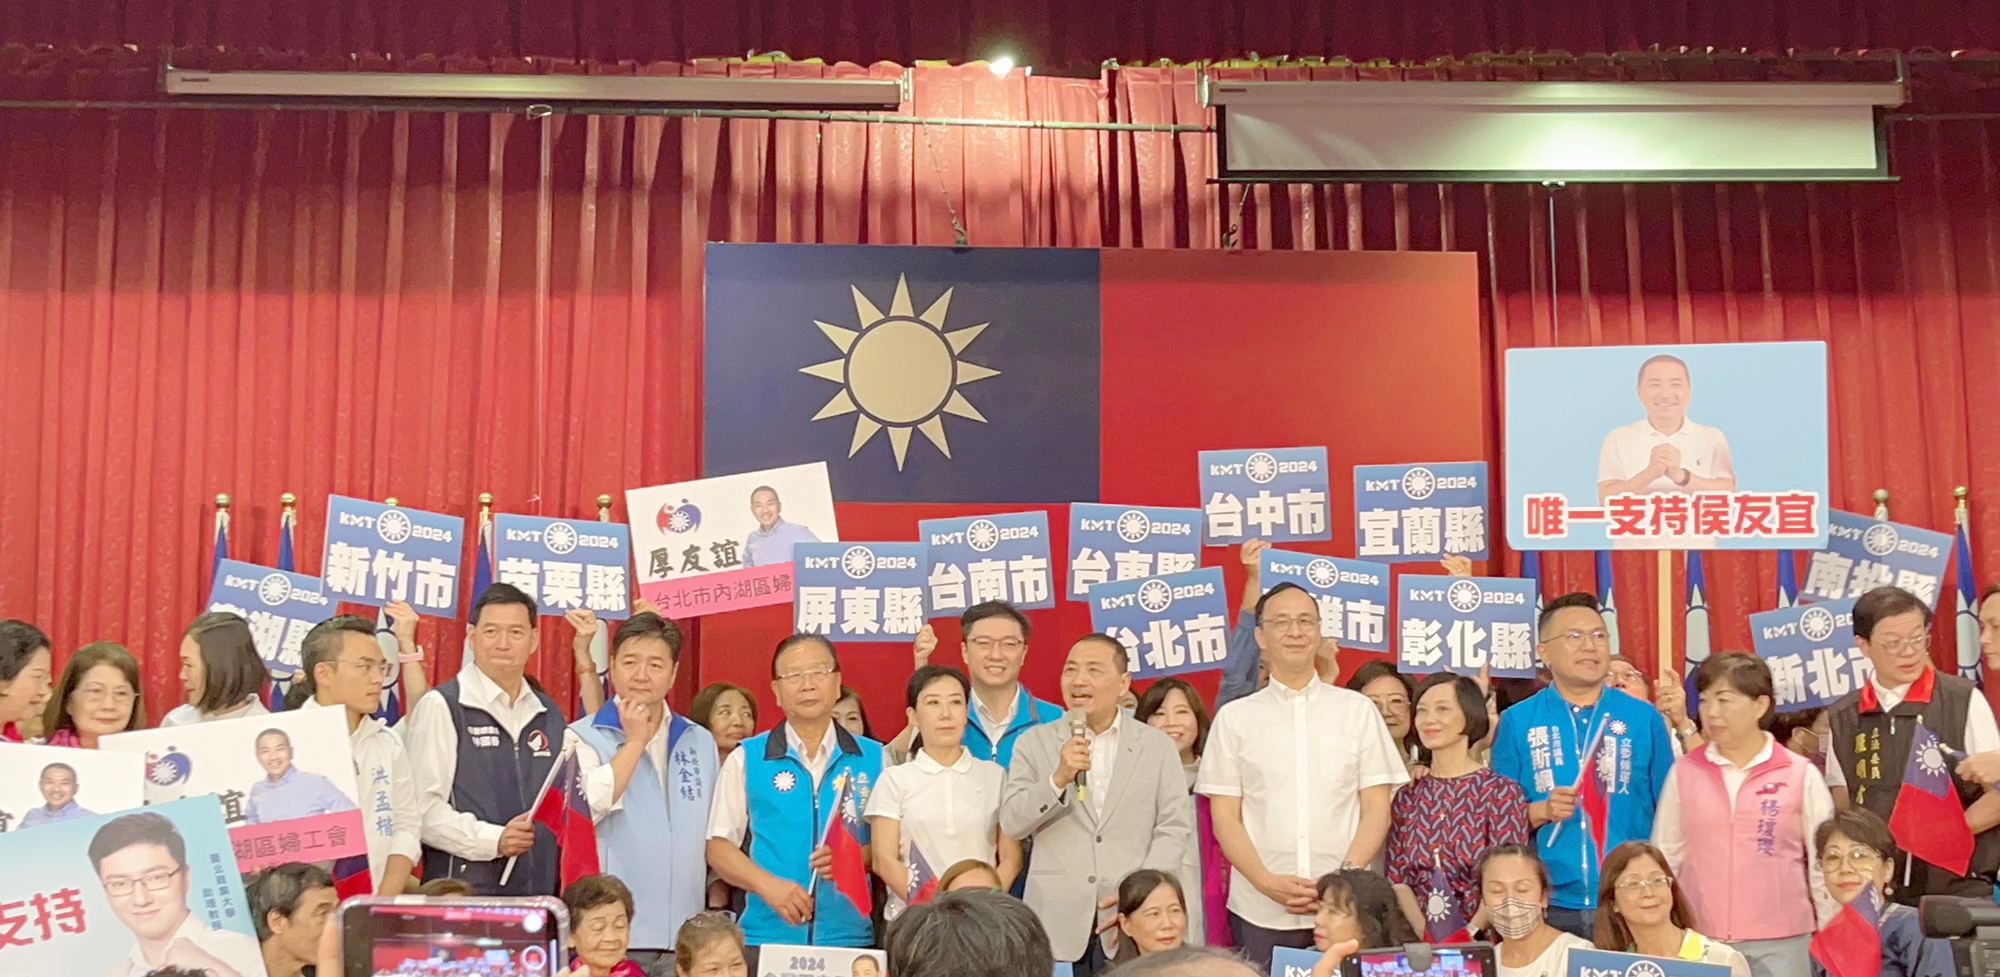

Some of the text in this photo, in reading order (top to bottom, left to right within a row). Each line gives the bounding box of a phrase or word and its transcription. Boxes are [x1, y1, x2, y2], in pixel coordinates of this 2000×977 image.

[1210, 460, 1318, 476] KMT 2024
[1365, 475, 1477, 492] KMT 2024
[338, 511, 453, 543] KMT 2024
[1080, 517, 1192, 535] KMT 2024
[1205, 488, 1325, 538] 台中市
[1525, 492, 1817, 537] 唯一支持侯友宜
[506, 528, 619, 549] KMT 2024
[931, 525, 1039, 546] KMT 2024
[1358, 506, 1485, 556] 宜蘭縣
[648, 539, 743, 579] 厚友誼
[805, 556, 917, 570] KMT 2024
[1897, 539, 1939, 559] 2024
[326, 541, 457, 609] 新竹市
[499, 557, 626, 612] 苗栗縣
[927, 555, 1049, 610] 台南市
[1270, 561, 1380, 586] KMT 2024
[224, 574, 329, 606] KMT 2024
[1101, 582, 1215, 610] KMT 2024
[1409, 588, 1525, 605] KMT 2024
[797, 586, 924, 634] 屏東縣
[1763, 613, 1854, 640] KMT 20
[1401, 618, 1533, 669] 彰化縣
[371, 766, 394, 837] 洪孟楷
[790, 956, 825, 972] 2024
